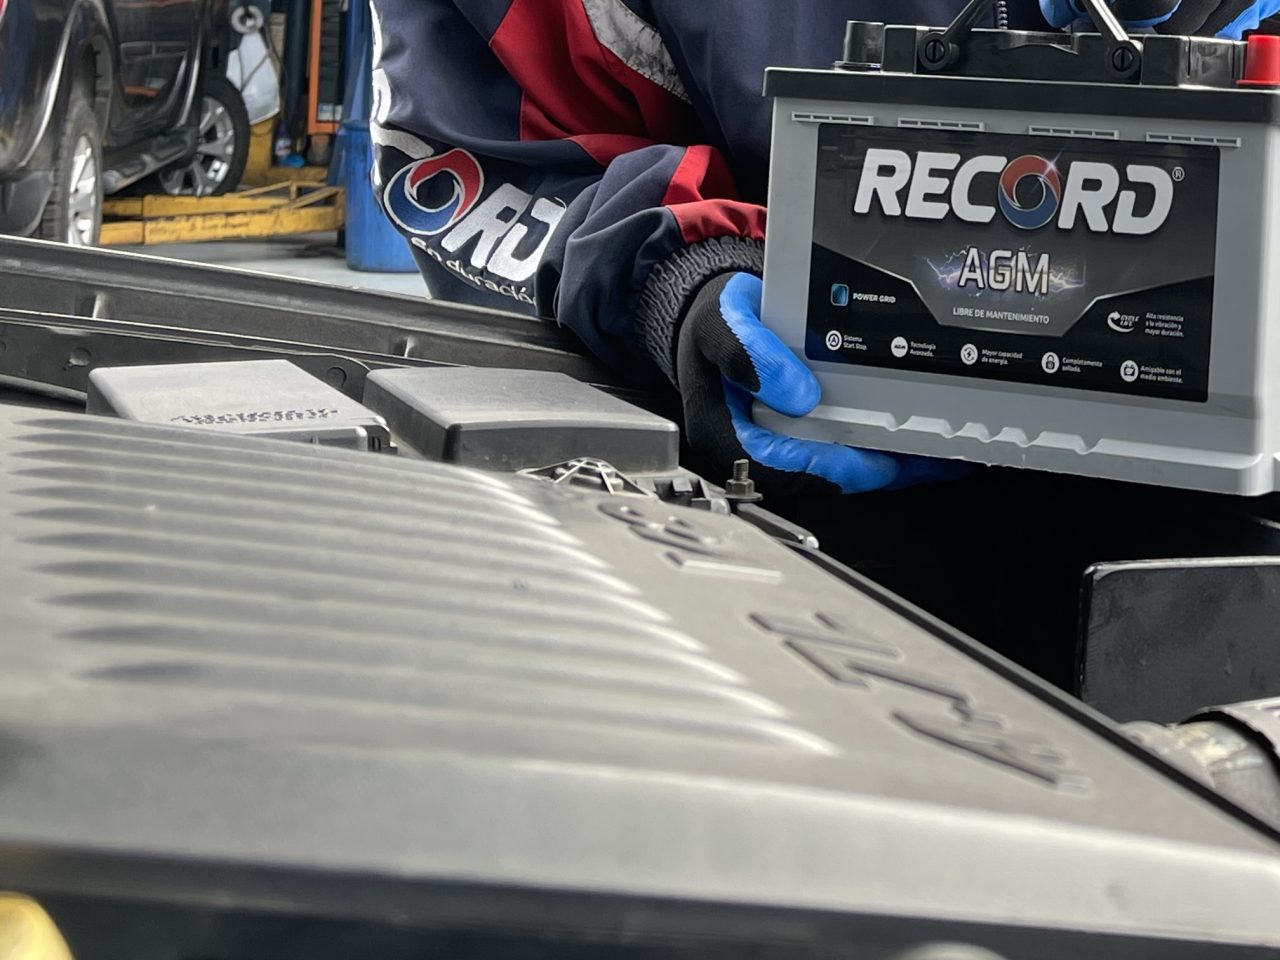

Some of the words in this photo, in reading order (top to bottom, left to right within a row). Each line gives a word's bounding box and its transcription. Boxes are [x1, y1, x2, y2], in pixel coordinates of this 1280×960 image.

[958, 246, 1050, 294] AGM
[852, 292, 878, 302] POWER
[879, 295, 896, 304] GRID
[952, 307, 974, 317] LIBRE
[975, 309, 985, 318] DE
[986, 310, 1050, 324] MANTENIMIENTO
[843, 334, 863, 342] Sistema
